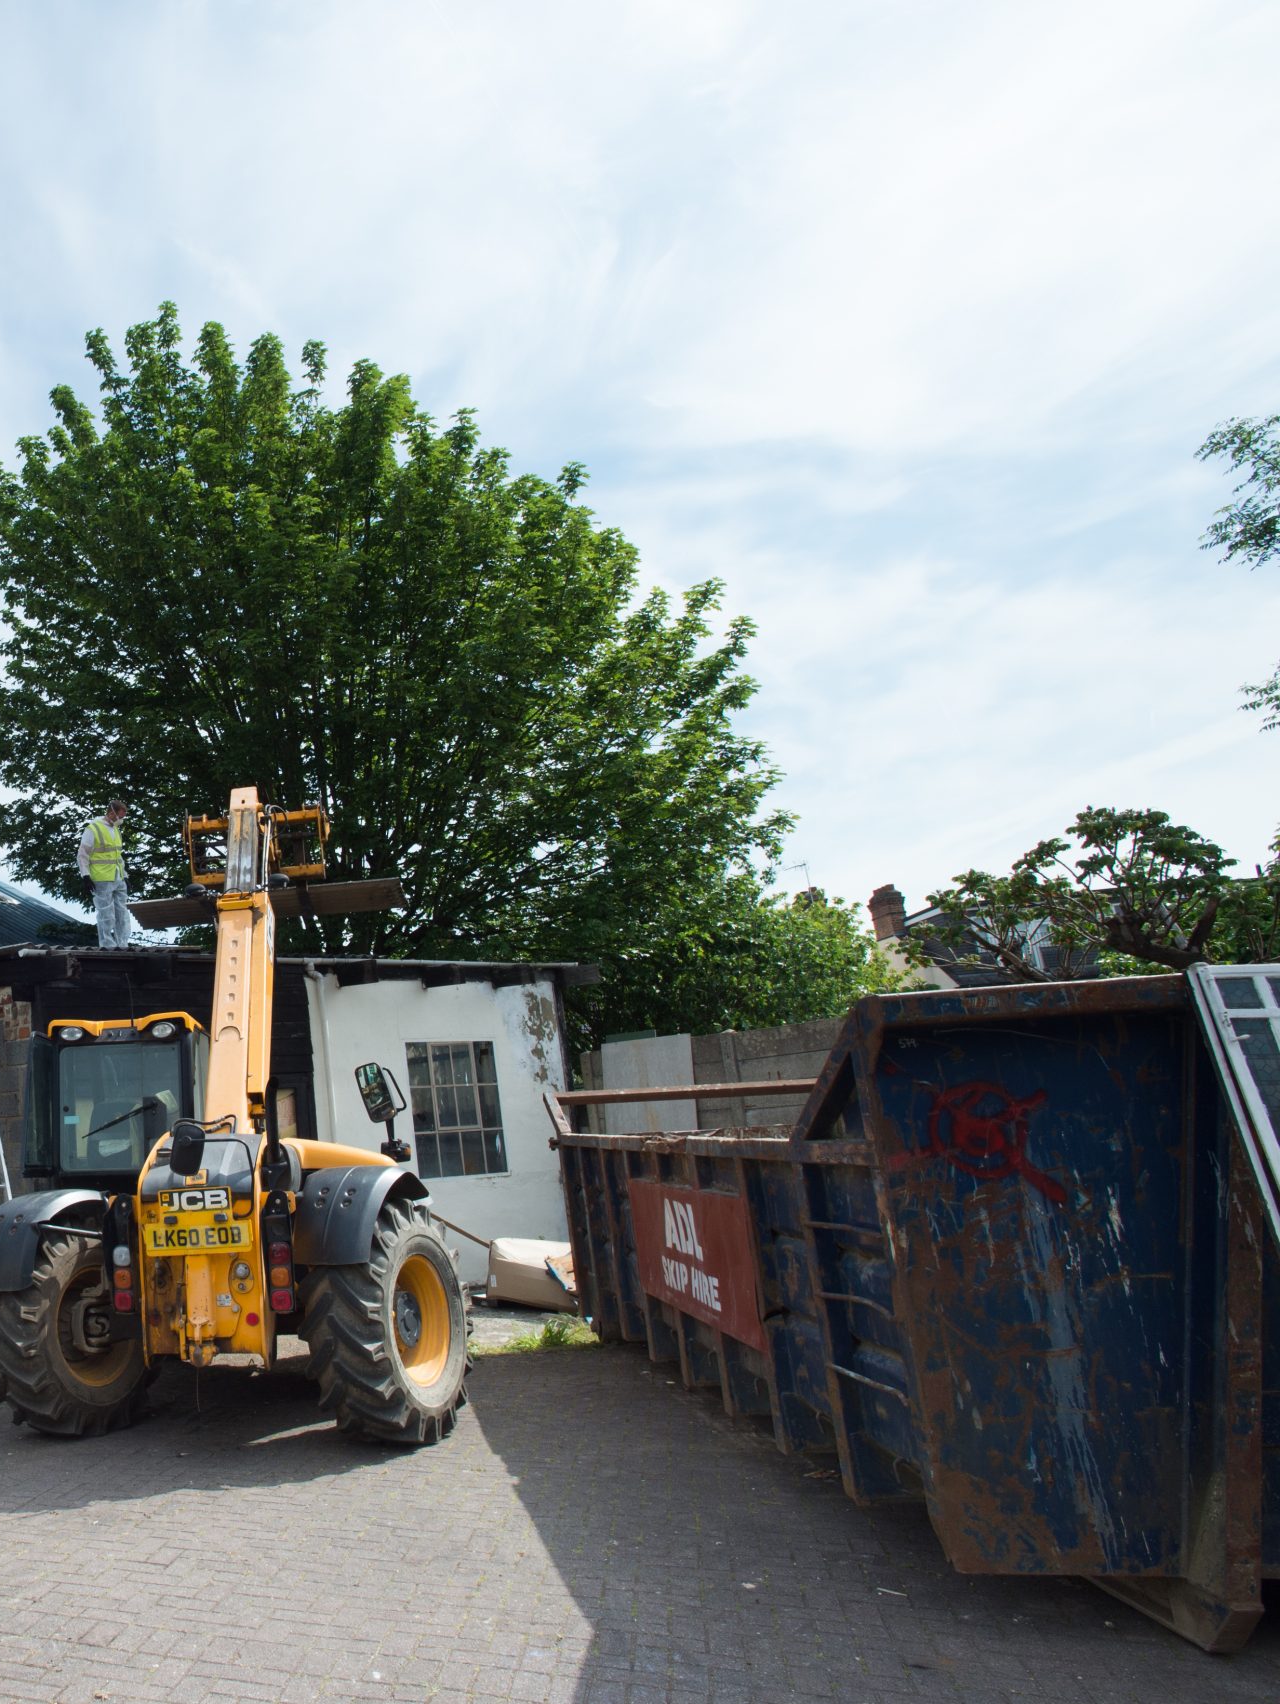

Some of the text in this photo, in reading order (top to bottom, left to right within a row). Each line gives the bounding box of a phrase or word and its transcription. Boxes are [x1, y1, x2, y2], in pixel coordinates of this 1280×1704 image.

[160, 1189, 229, 1212] JCB
[153, 1228, 200, 1248] LK60
[663, 1198, 704, 1262] ADL
[661, 1255, 722, 1312] SKIP HIRE
